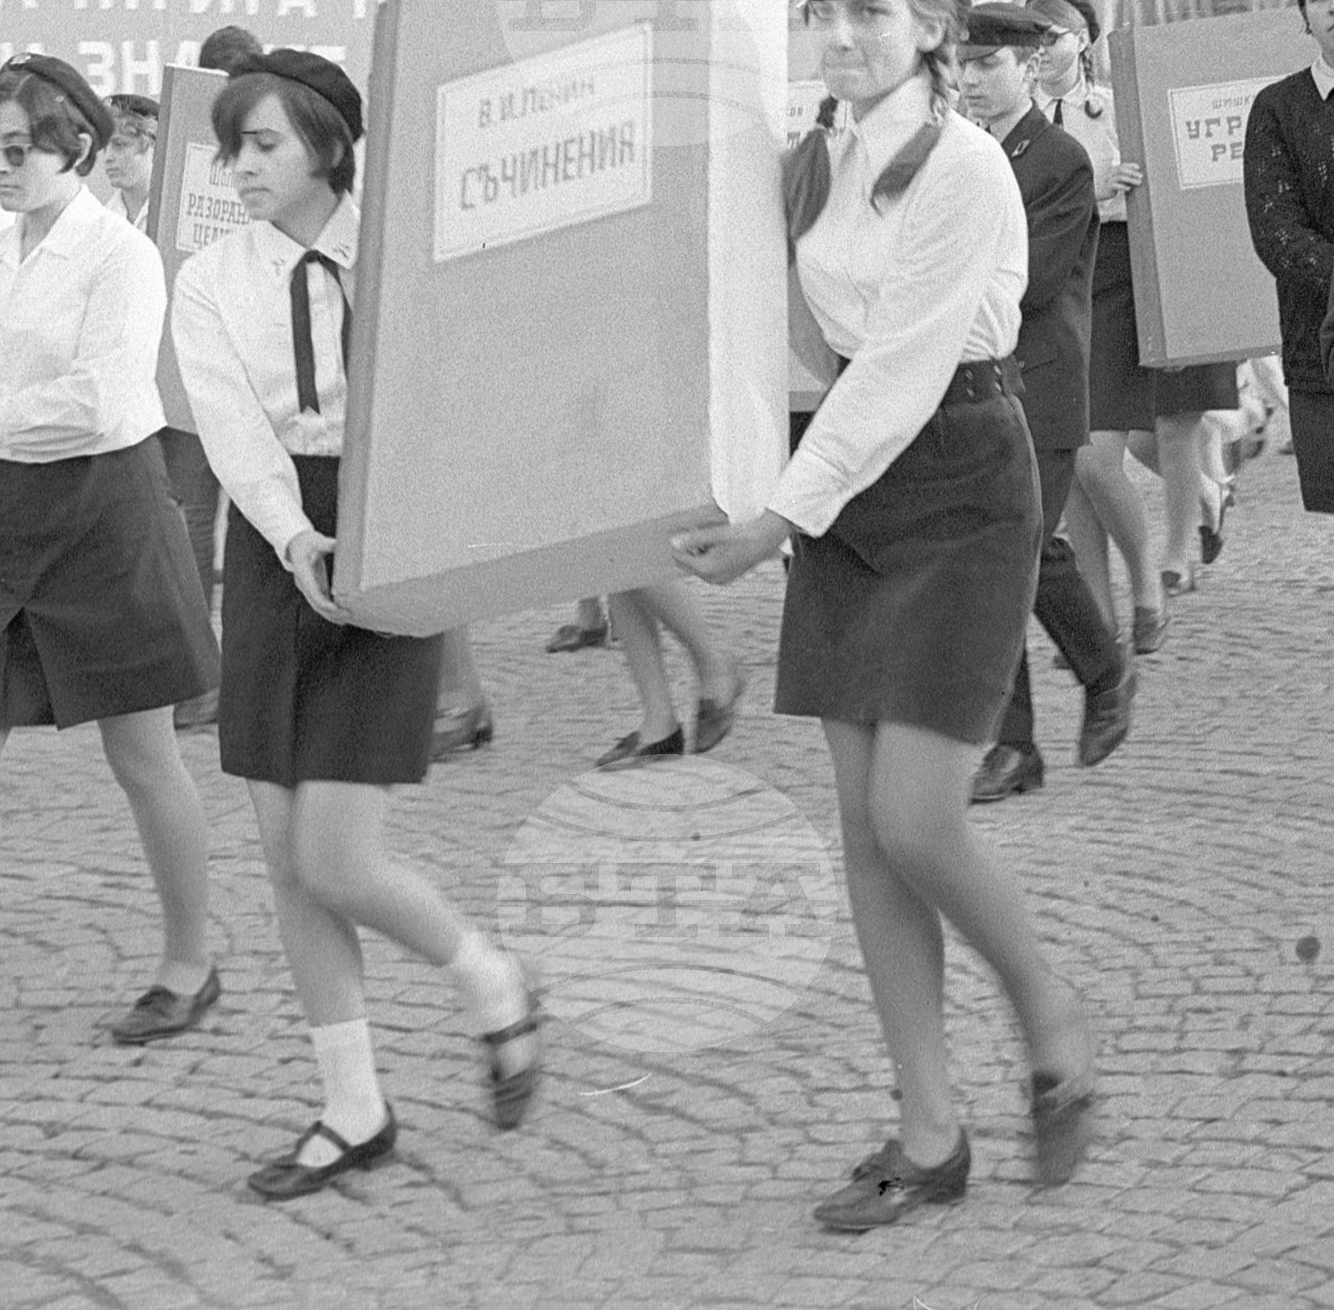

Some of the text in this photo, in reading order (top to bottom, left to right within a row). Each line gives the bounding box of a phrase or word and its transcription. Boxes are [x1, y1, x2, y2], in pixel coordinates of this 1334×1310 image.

[1185, 115, 1242, 140] УГР
[461, 119, 634, 210] СЪЧИНЕНИЯ
[1211, 141, 1243, 162] РЕ
[186, 192, 250, 225] РАЗОРАН
